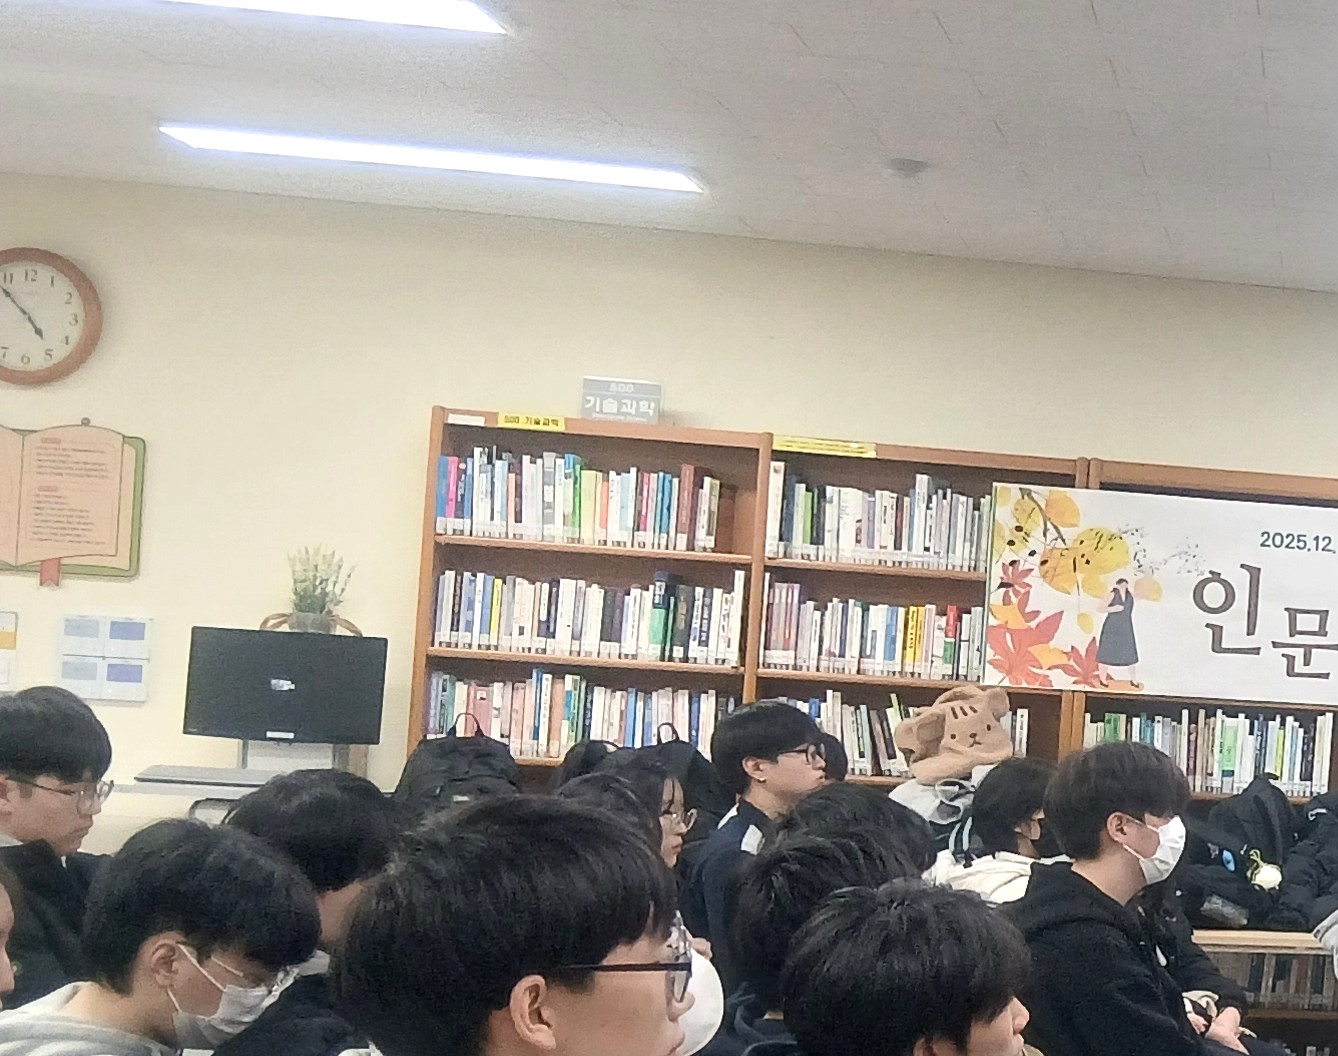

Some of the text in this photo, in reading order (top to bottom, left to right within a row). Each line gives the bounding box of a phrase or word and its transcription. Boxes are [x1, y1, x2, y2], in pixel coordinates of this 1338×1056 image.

[4, 272, 13, 284] 11
[25, 269, 38, 282] 12
[64, 292, 72, 304] 2
[69, 313, 78, 326] 3
[1, 346, 9, 359] 7
[21, 353, 31, 364] 6
[44, 349, 53, 361] 5
[584, 395, 655, 416] 기술과학
